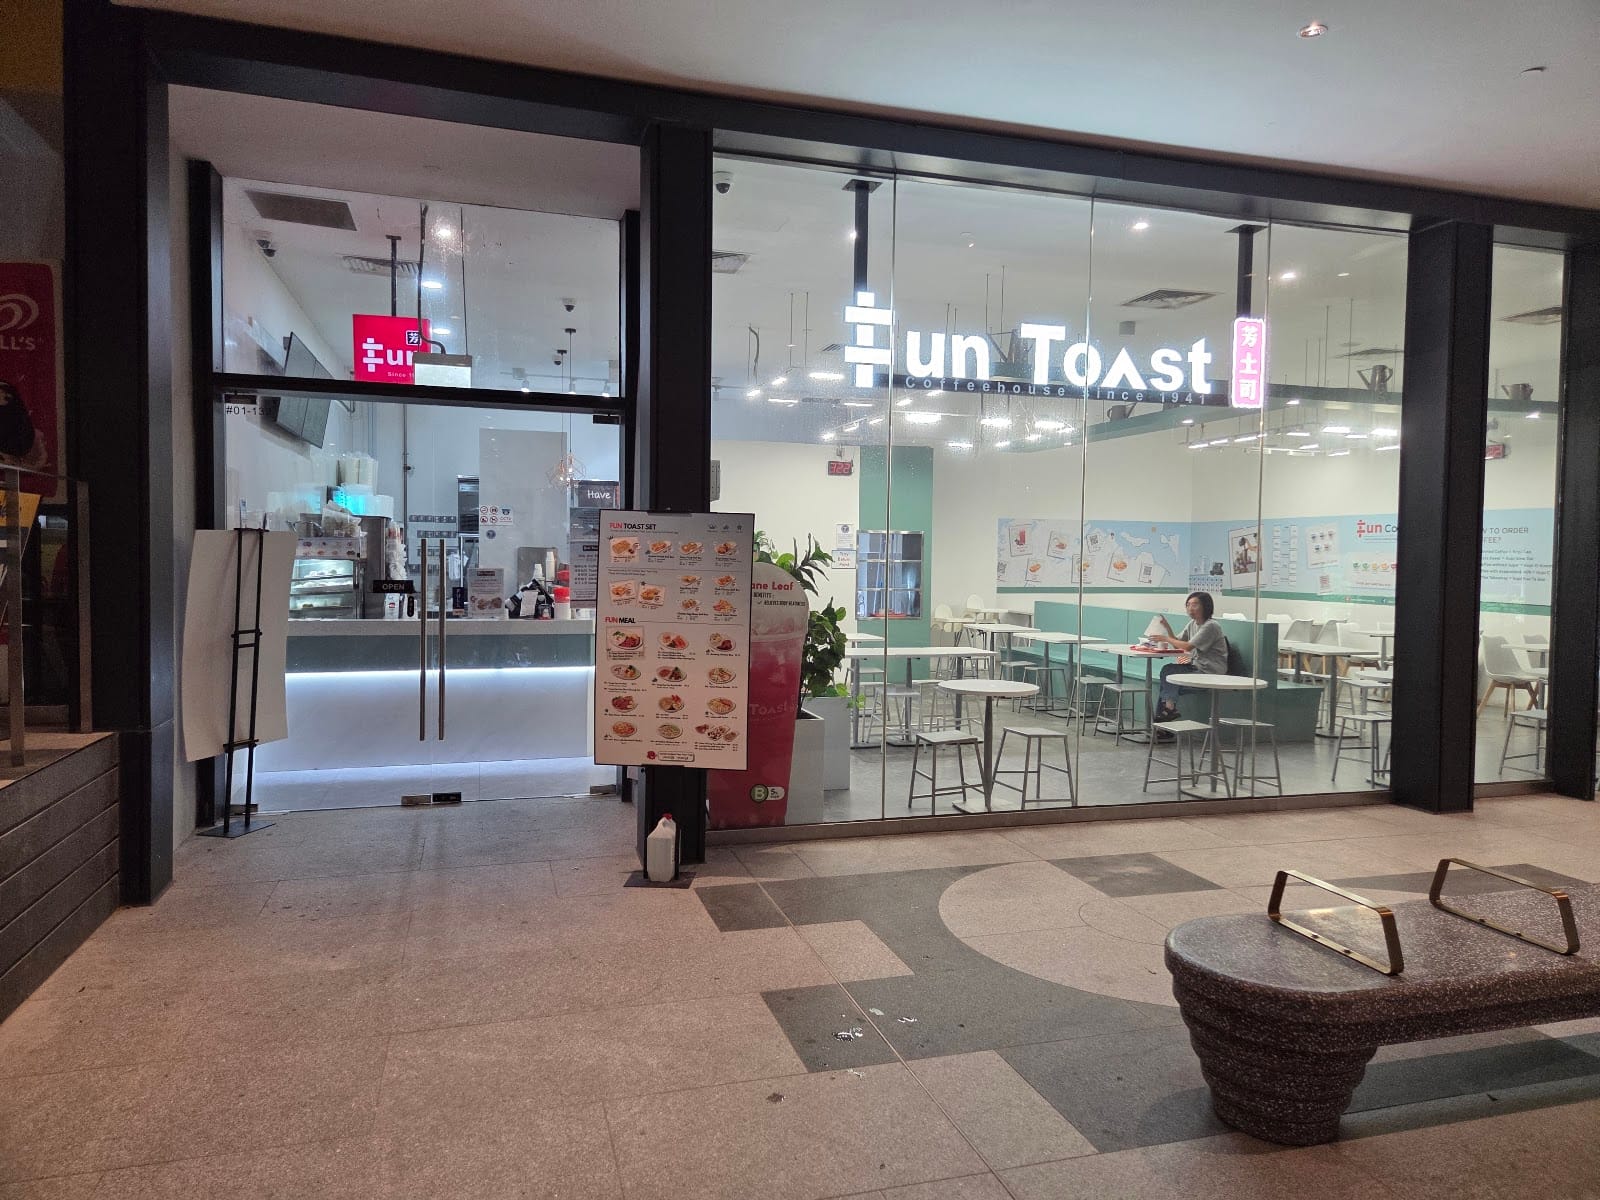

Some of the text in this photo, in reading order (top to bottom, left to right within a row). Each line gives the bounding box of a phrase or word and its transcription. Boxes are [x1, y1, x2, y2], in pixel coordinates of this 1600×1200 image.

[1020, 323, 1212, 395] Toast
[1238, 325, 1259, 401] 芳土司
[905, 375, 1066, 396] Coffeehouse
[587, 489, 611, 499] Have
[609, 522, 657, 531] FUN TOAST SET
[382, 583, 405, 591] OPEN
[771, 581, 794, 591] Leaf
[604, 616, 636, 625] FUN MEAL
[754, 786, 765, 800] B
